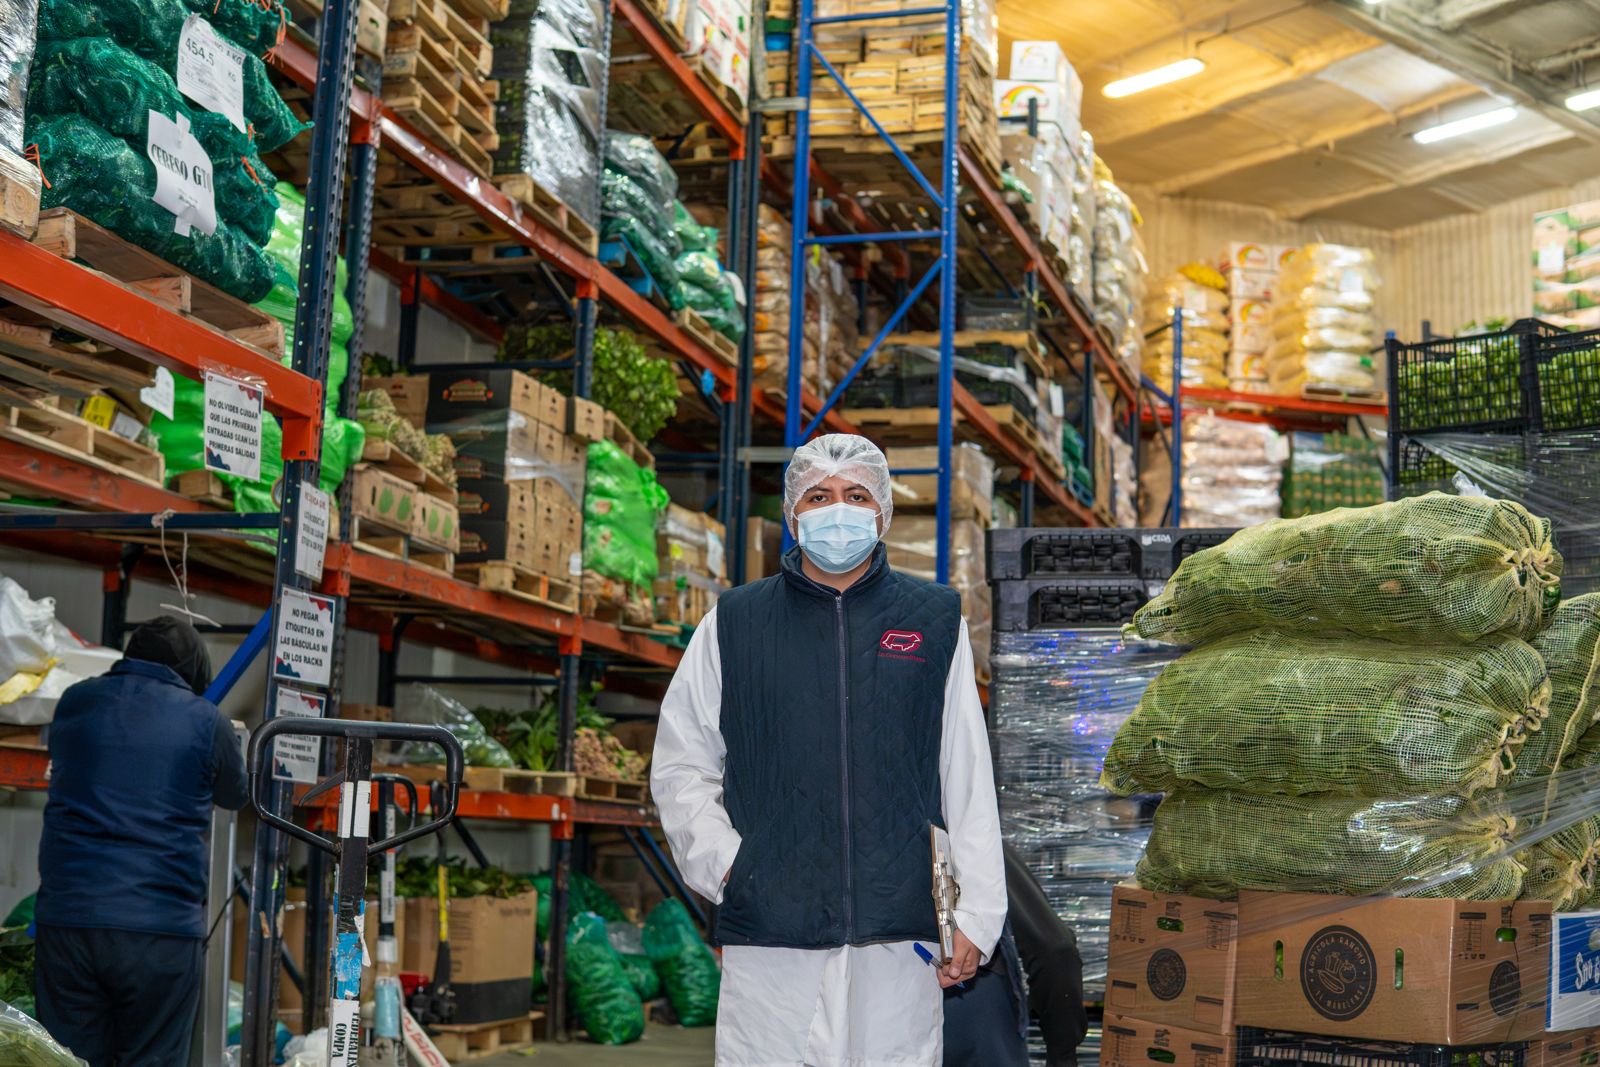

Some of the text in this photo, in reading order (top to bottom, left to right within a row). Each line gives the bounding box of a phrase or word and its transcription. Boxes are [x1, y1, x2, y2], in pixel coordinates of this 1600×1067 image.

[185, 38, 215, 66] 454.5
[209, 398, 259, 419] NO OLVIDES CUIDAR
[209, 412, 257, 433] QUE LAS PRIMERAS
[207, 425, 234, 440] ENTRADAS
[248, 435, 258, 447] LAS
[208, 440, 256, 460] PRIMERAS SALIDAS
[292, 607, 319, 622] NO PEGAR
[285, 621, 324, 638] ETIQUETAS EN
[280, 635, 290, 645] LAS
[321, 644, 328, 653] NI
[282, 651, 323, 667] EN LOS RACKS
[331, 1022, 348, 1059] COMPA
